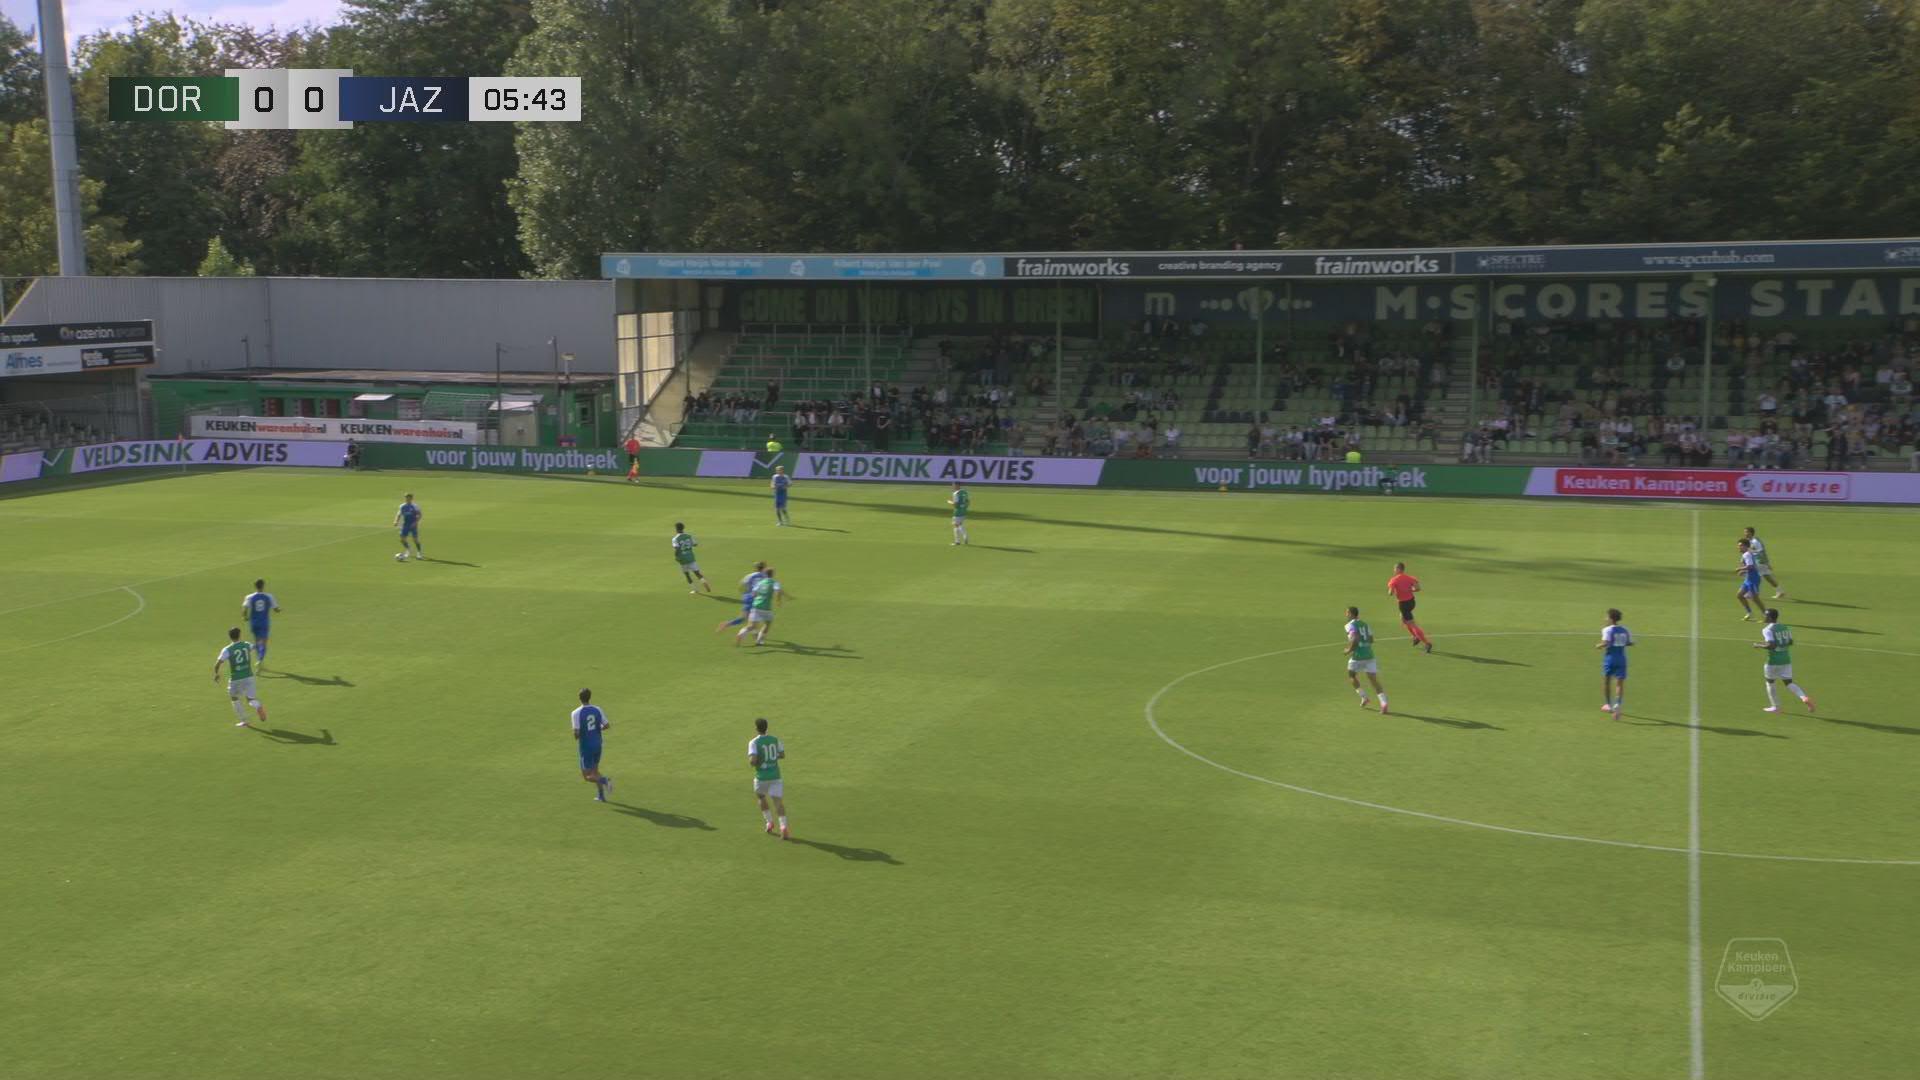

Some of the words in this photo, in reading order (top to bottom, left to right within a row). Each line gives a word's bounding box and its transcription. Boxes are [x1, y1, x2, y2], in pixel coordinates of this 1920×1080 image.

[1016, 257, 1130, 275] fraimworks
[1157, 260, 1198, 270] creative
[1199, 259, 1244, 272] branding
[1245, 261, 1284, 272] agency
[1315, 255, 1440, 275] fraimworks
[82, 443, 195, 467] VELDSINK
[203, 441, 288, 462] ADVIES
[426, 449, 466, 466] voor
[471, 448, 516, 470] jouw
[521, 448, 619, 471] hypotheek
[809, 455, 934, 479] VELDSINK
[940, 457, 1035, 482] ADVIES
[1195, 466, 1243, 484] voor
[1248, 463, 1303, 489] jouw
[1563, 474, 1631, 490] Keuken
[1634, 476, 1729, 495] Kampioen
[1760, 479, 1841, 494] divisie
[233, 647, 249, 664] 21
[586, 714, 596, 731] 2
[762, 743, 777, 762] 10
